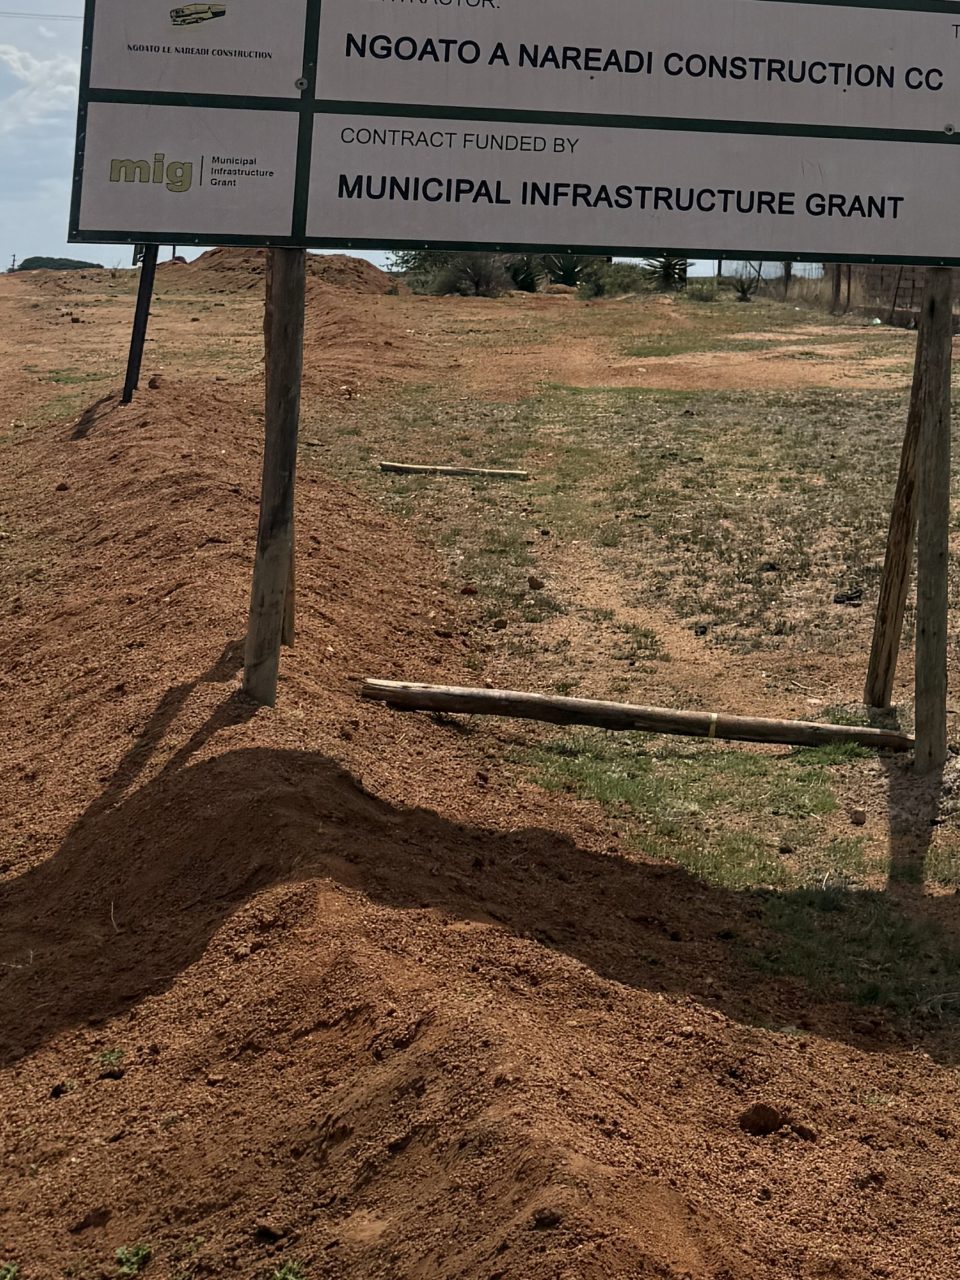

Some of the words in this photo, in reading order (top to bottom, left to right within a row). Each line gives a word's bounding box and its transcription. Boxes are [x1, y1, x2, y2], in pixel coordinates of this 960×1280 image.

[211, 49, 273, 60] CONSTRUCTION
[345, 32, 481, 65] NGOATO
[487, 42, 511, 67] A
[518, 43, 654, 75] NAREADI
[663, 51, 895, 89] CONSTRUCTION
[904, 66, 944, 91] CC
[340, 127, 457, 150] CONTRACT
[462, 133, 548, 154] FUNDED
[553, 137, 580, 154] BY
[211, 155, 257, 167] Municipal
[109, 152, 193, 193] mig
[210, 167, 275, 178] Infrastructure
[210, 177, 237, 188] Grant
[337, 173, 512, 206] MUNICIPAL
[521, 181, 796, 216] INFRASTRUCTURE
[805, 192, 905, 220] GRANT
